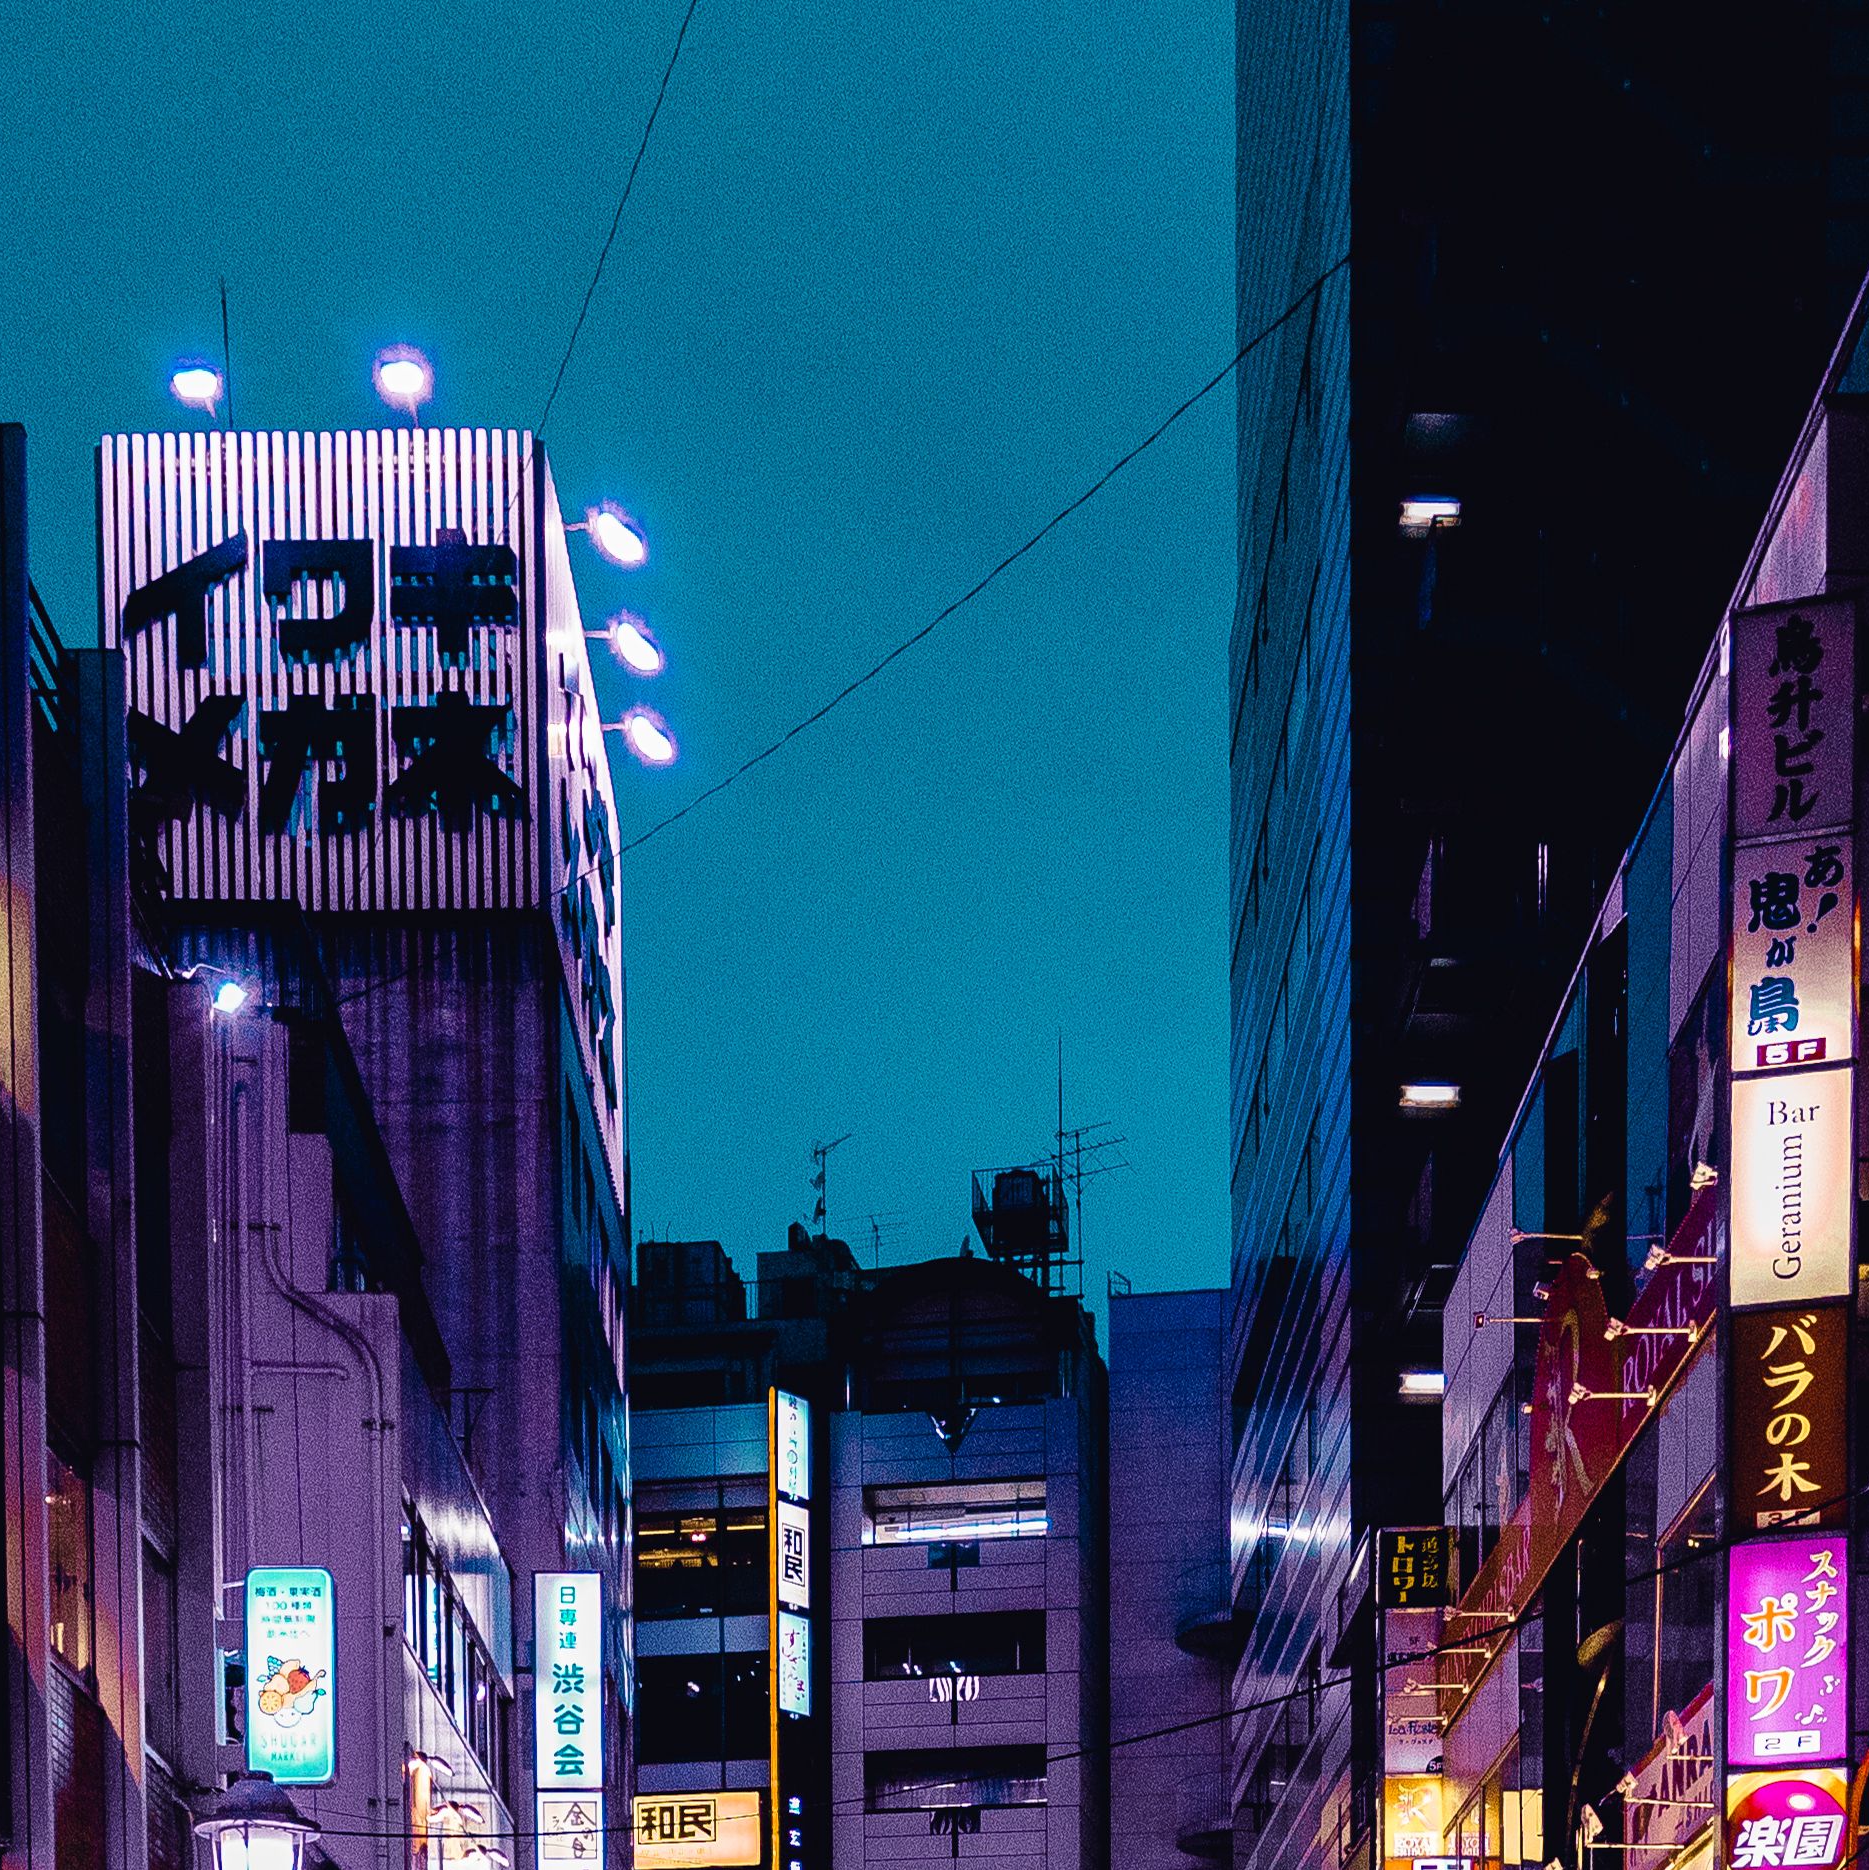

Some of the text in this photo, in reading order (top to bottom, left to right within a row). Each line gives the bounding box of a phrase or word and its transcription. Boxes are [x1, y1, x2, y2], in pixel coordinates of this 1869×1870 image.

[1764, 1042, 1819, 1065] 5F
[1768, 1101, 1820, 1126] Bar
[1773, 1133, 1803, 1280] Geranium
[1756, 1314, 1821, 1501] バラの木
[783, 1528, 805, 1582] 和民
[559, 1587, 577, 1650] 日専連
[1801, 1550, 1839, 1668] スナック
[552, 1663, 585, 1777] 渋谷会
[1762, 1736, 1814, 1751] 2F
[640, 1802, 715, 1843] 和民
[1732, 1814, 1843, 1868] 楽園
